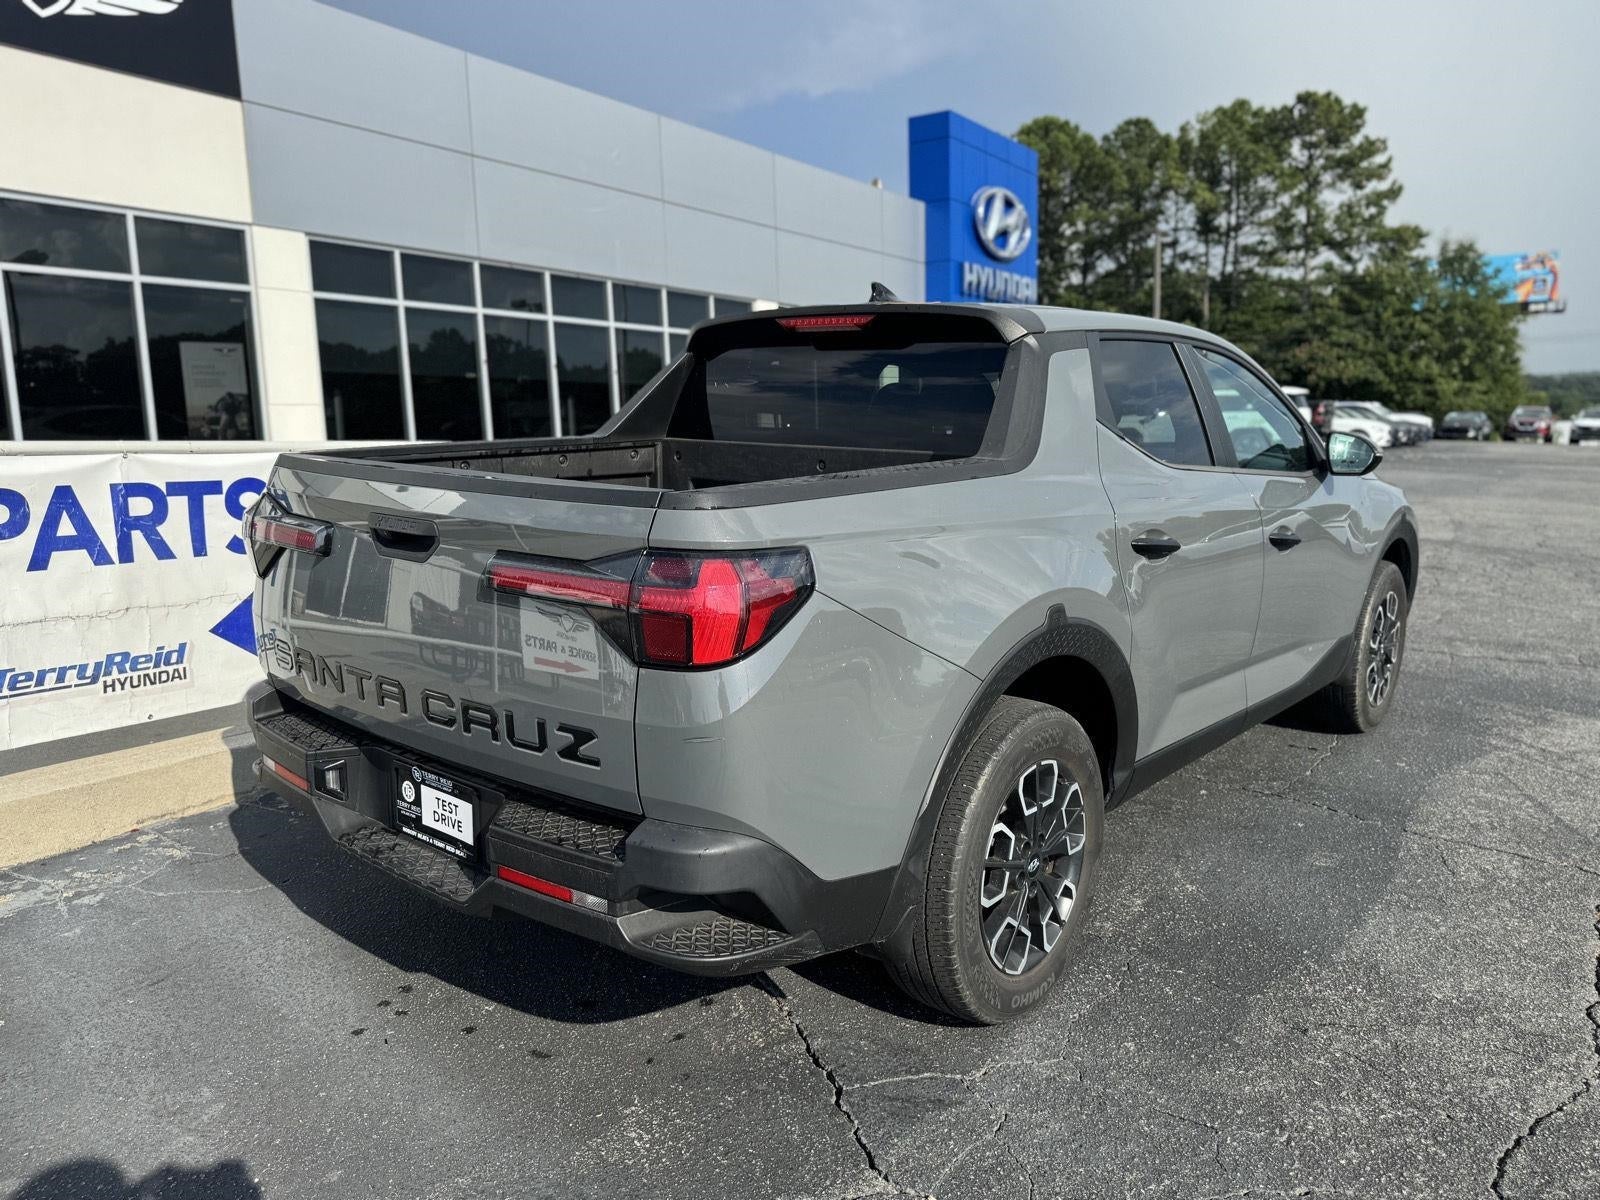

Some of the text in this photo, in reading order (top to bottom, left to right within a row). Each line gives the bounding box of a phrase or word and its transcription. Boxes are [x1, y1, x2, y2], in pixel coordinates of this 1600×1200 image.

[963, 261, 1037, 304] HYUNDAI
[103, 667, 187, 694] HYUNDAI
[275, 638, 601, 770] SANTA CRUZ
[433, 811, 463, 833] DRIVE
[435, 797, 458, 816] TEST
[1011, 972, 1056, 1008] KUMHO
